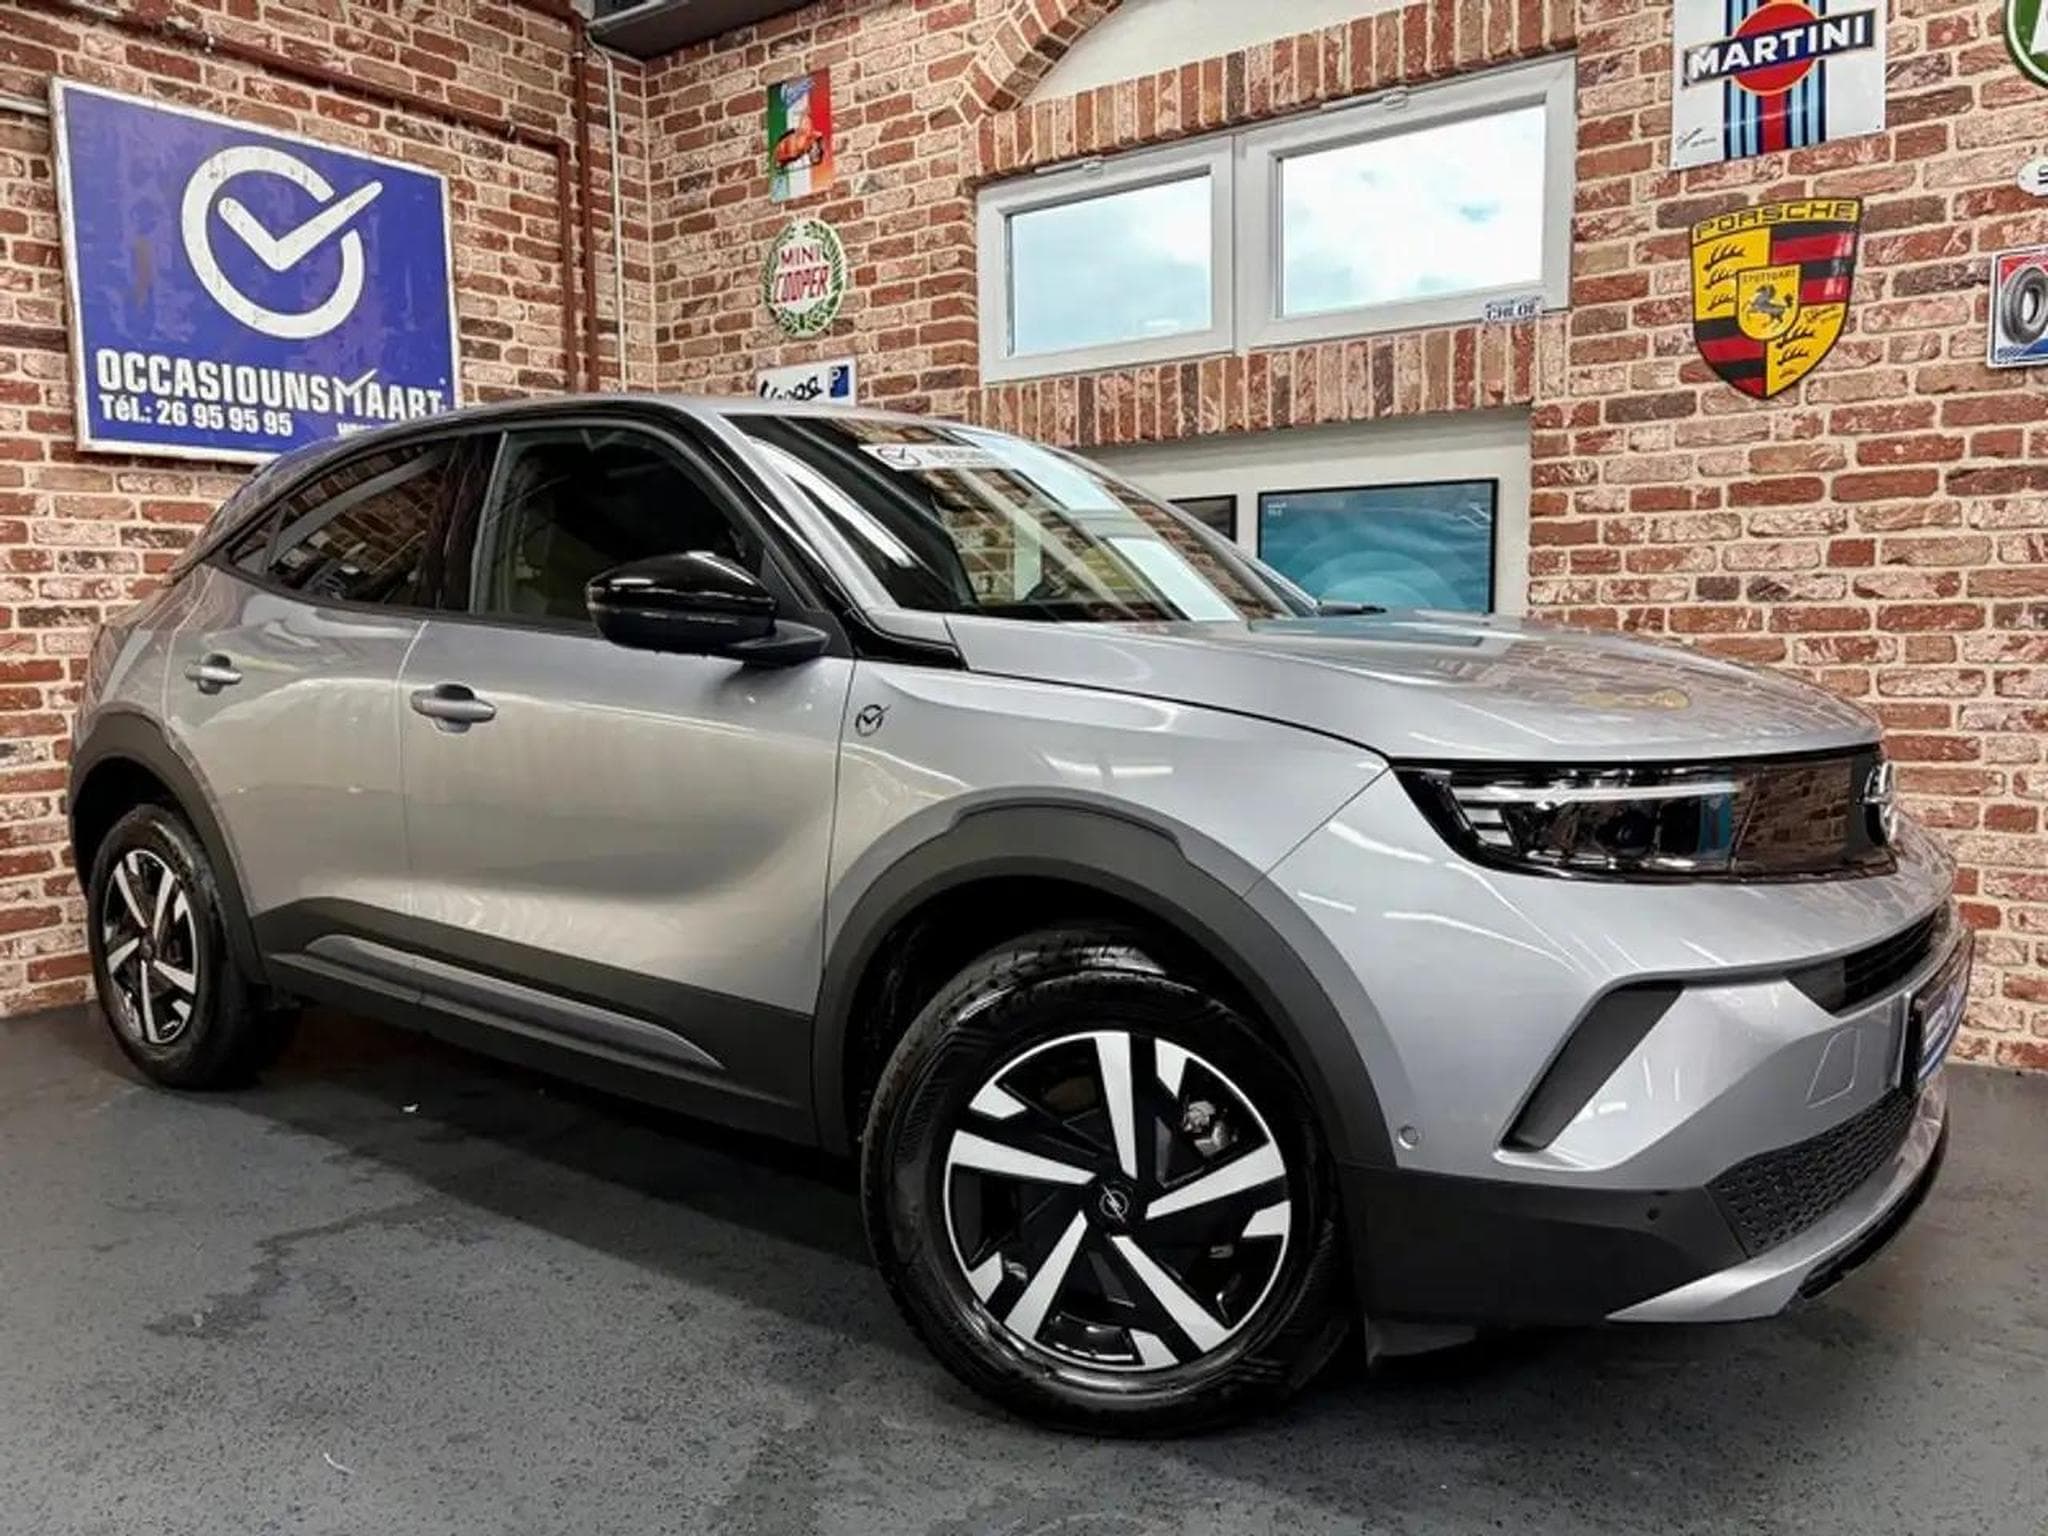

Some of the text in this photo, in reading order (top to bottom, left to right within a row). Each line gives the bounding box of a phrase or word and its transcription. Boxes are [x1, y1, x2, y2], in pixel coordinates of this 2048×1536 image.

[1687, 18, 1867, 77] MARTINI
[1697, 202, 1855, 239] PORSCHE
[781, 247, 820, 267] MINI
[774, 265, 829, 304] COOPER
[99, 394, 294, 437] Tél.: 26 95 95 95
